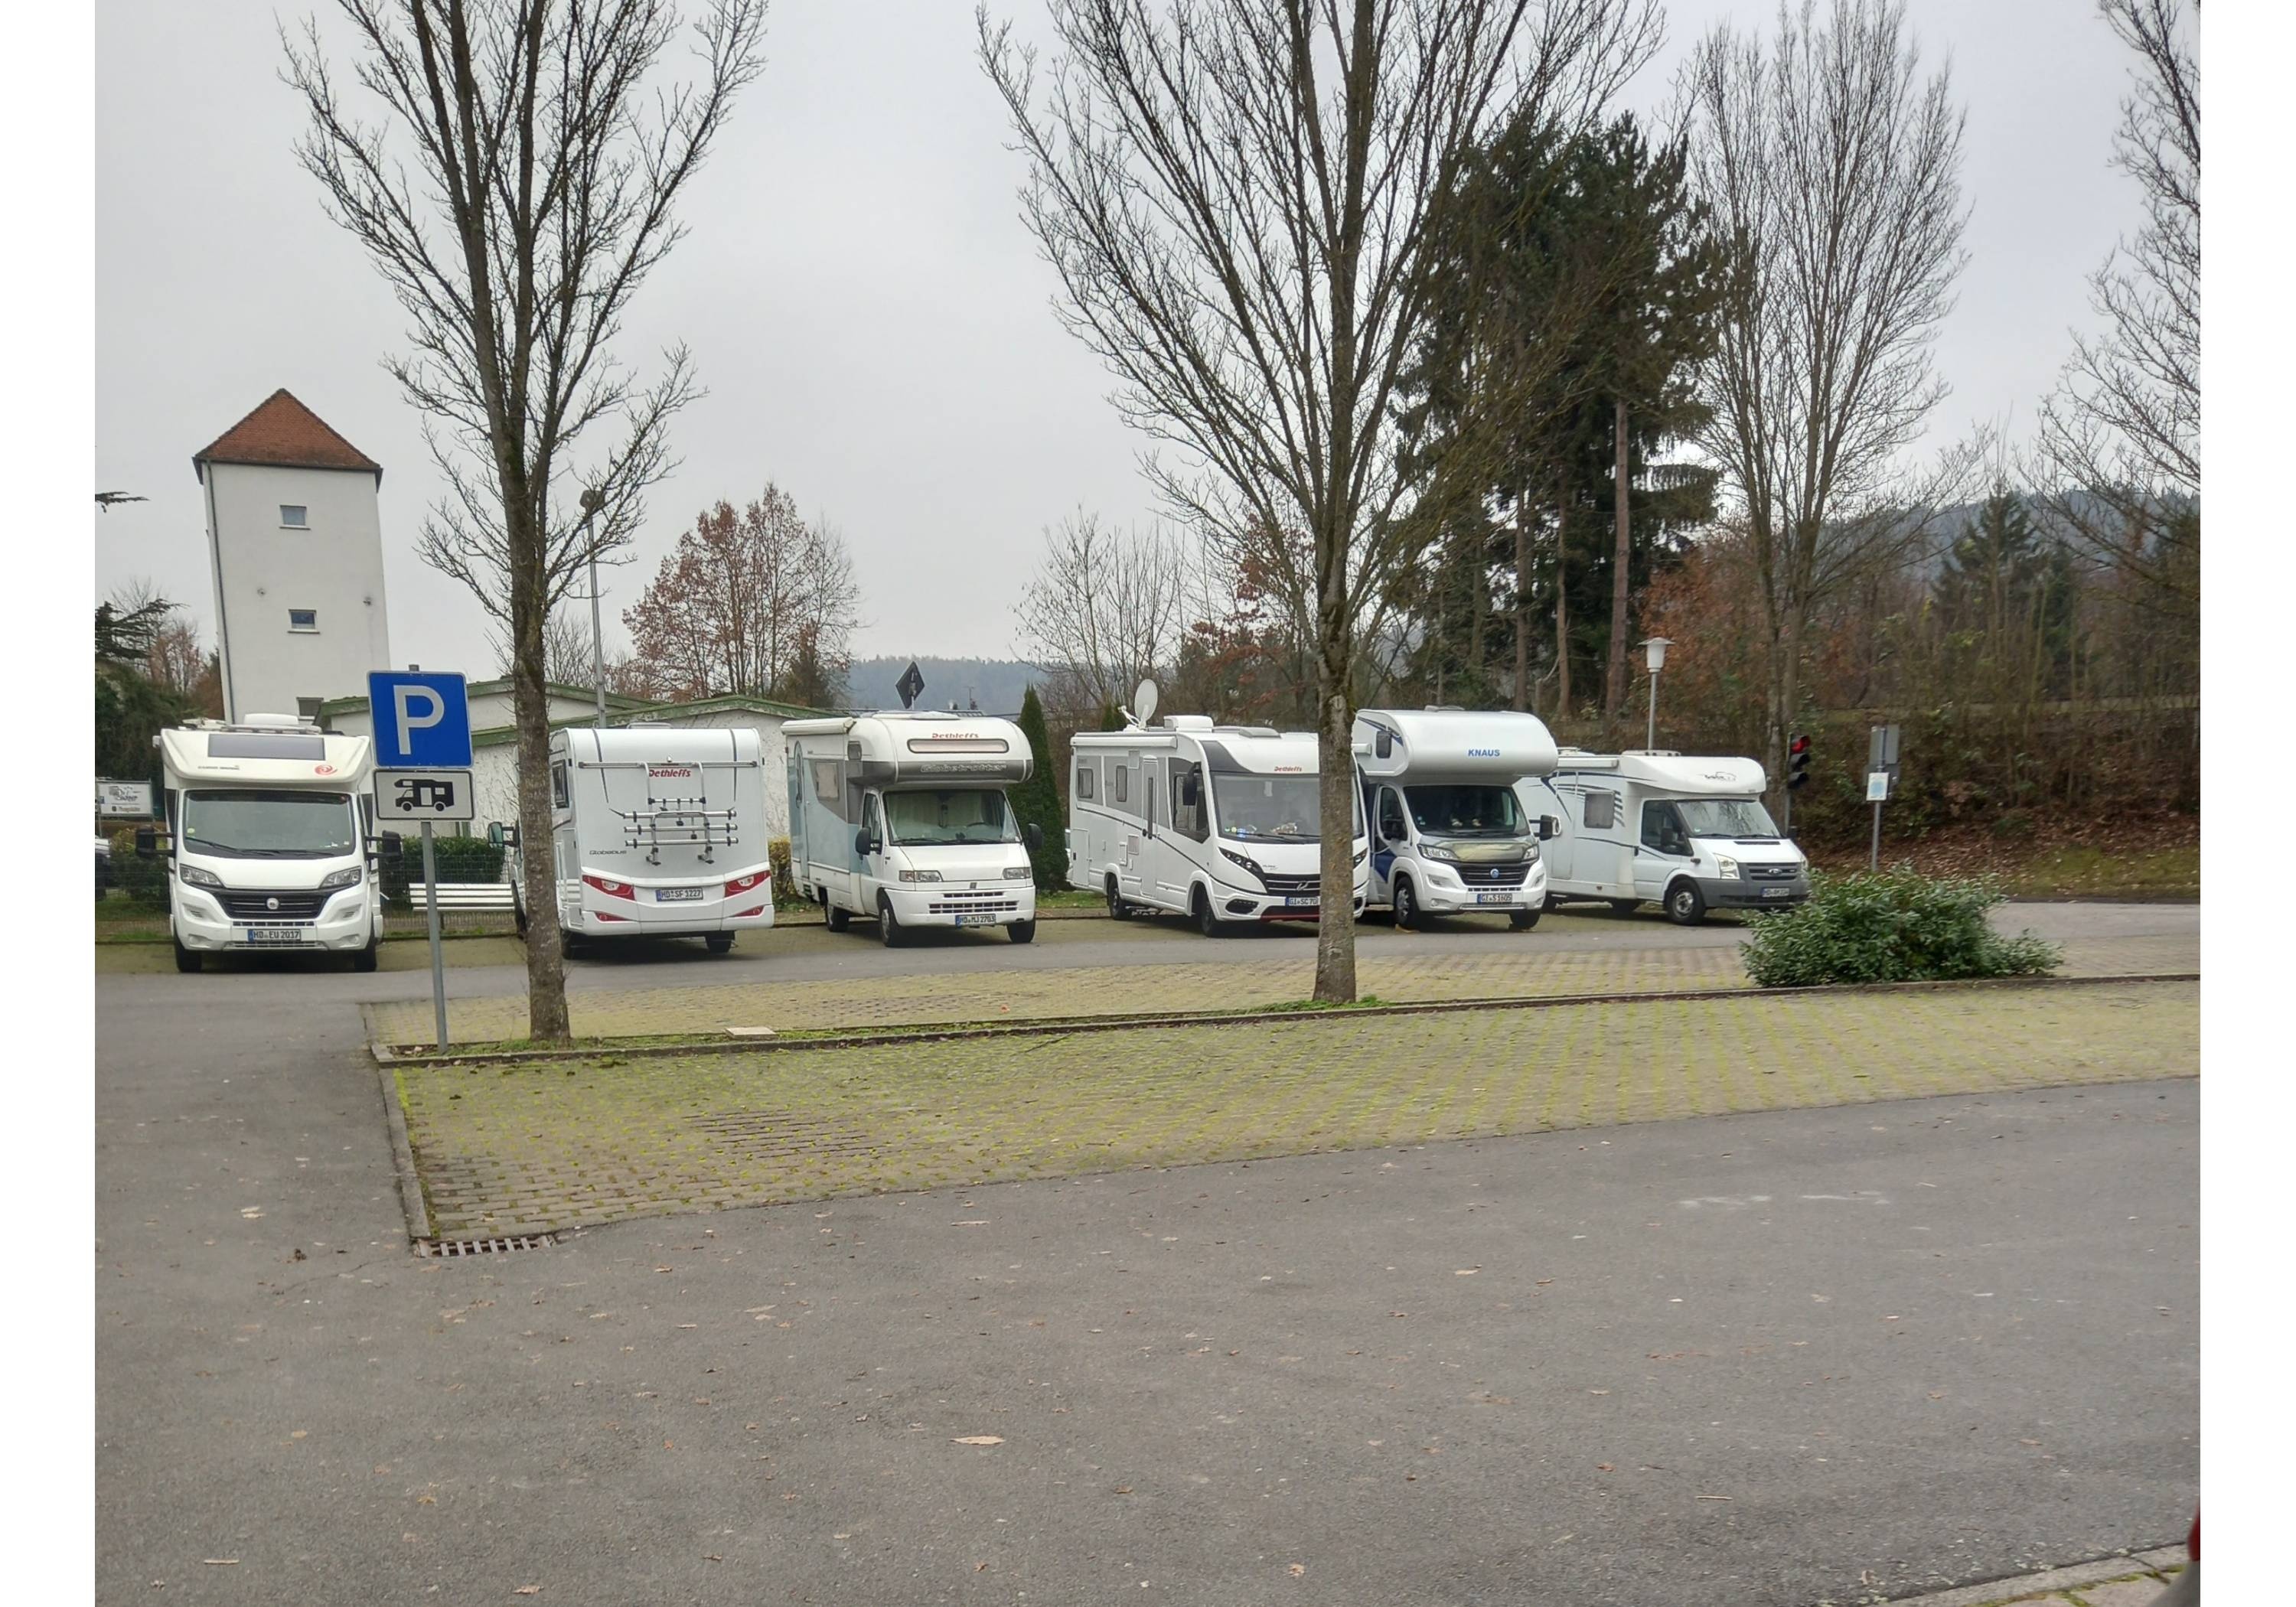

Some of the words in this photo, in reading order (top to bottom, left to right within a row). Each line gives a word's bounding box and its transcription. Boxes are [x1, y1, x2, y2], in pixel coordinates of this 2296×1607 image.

[393, 685, 445, 755] P
[648, 768, 691, 777] Dethleffs
[674, 889, 683, 898] SF
[684, 888, 701, 898] 1227
[253, 931, 264, 939] HD
[269, 931, 279, 939] EU
[280, 931, 300, 939] 2017
